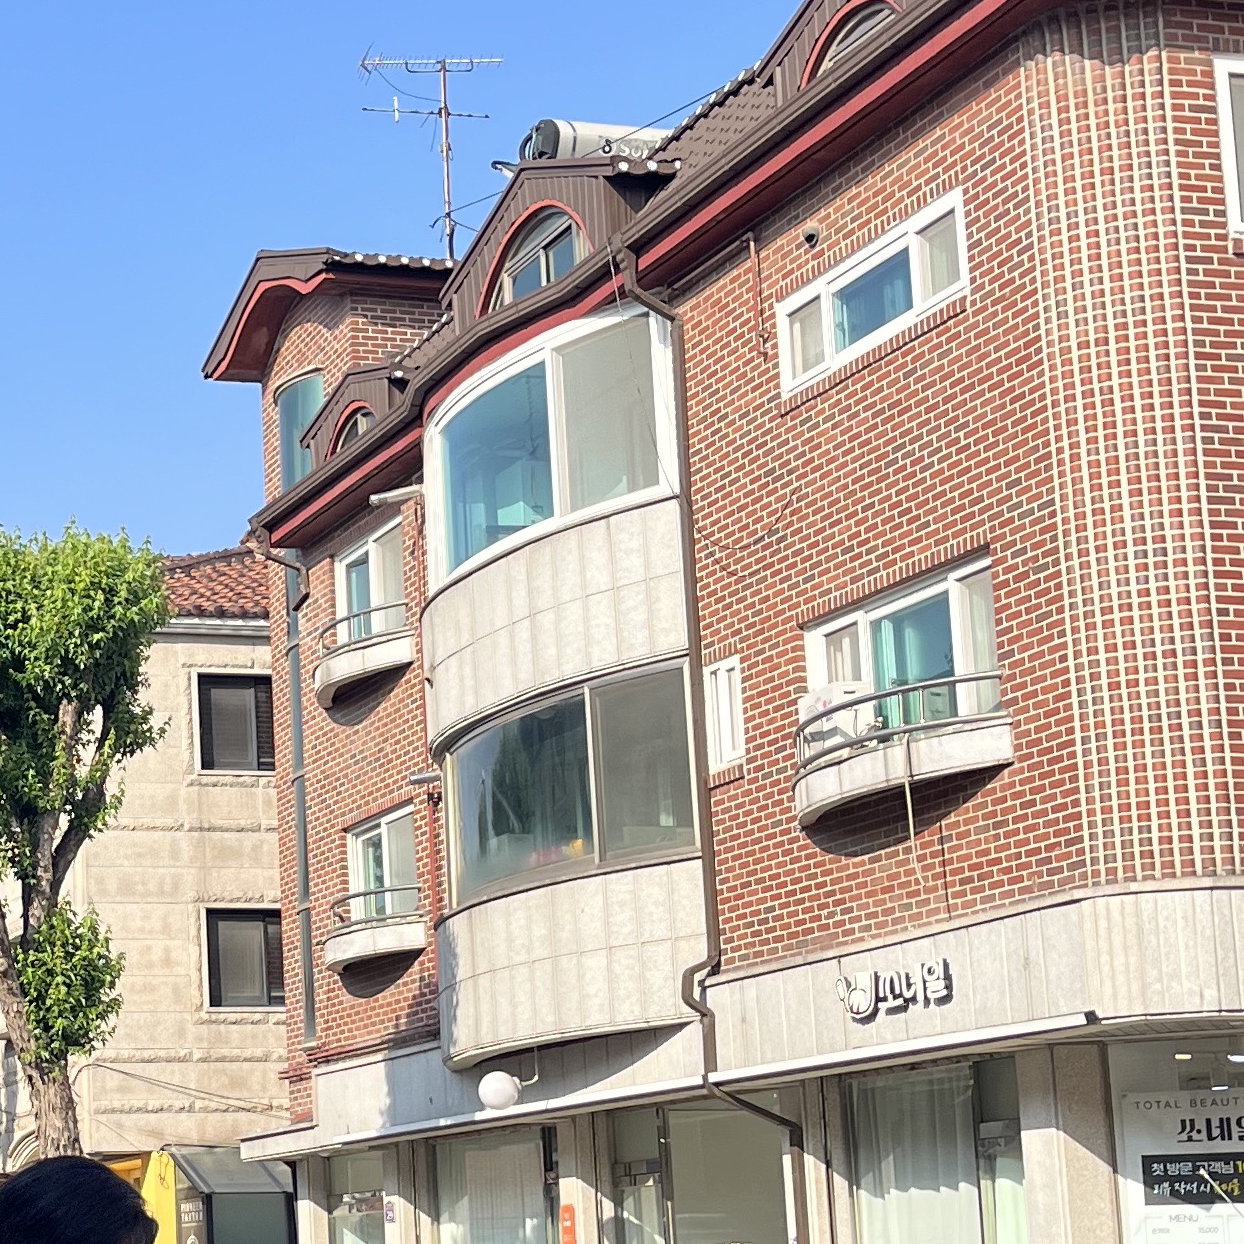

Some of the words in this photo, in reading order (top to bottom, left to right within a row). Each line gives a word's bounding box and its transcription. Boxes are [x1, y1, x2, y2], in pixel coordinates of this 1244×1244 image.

[1135, 1100, 1182, 1110] TOTAL
[1189, 1097, 1244, 1108] BEAUT
[1151, 1162, 1165, 1175] 첫
[1166, 1161, 1193, 1175] 방문
[1174, 1181, 1198, 1195] 작성
[1169, 1214, 1199, 1223] MENU
